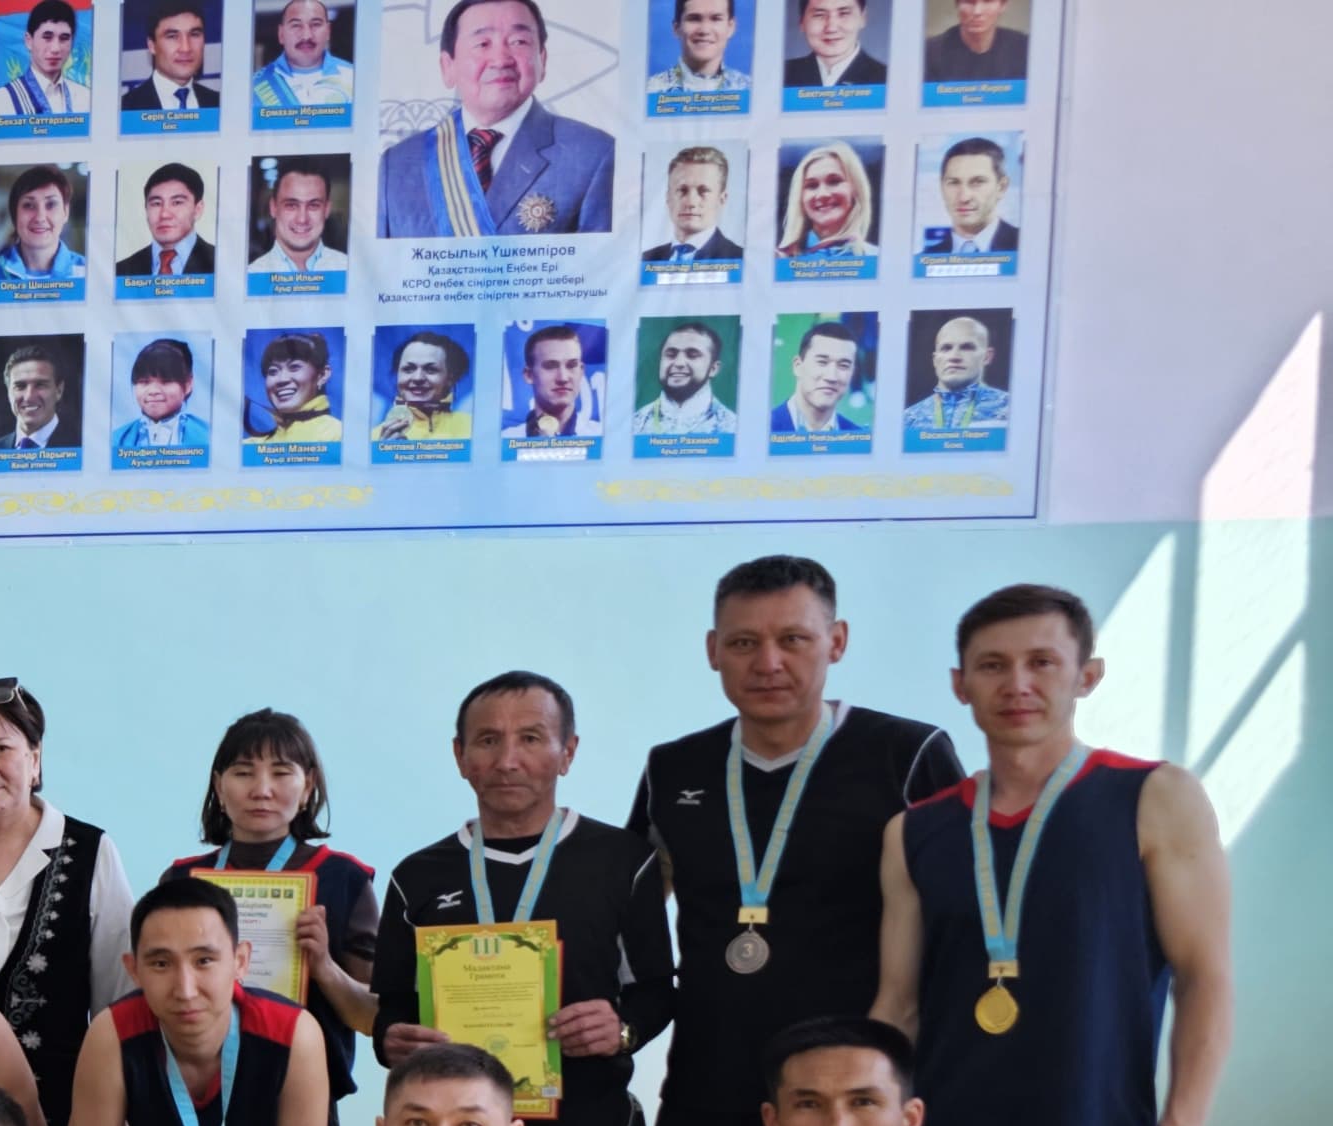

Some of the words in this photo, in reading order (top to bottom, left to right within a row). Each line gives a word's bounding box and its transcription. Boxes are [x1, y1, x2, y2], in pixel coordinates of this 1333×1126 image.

[411, 248, 488, 261] Жақсылық
[492, 245, 576, 259] Үшкемпіров
[506, 263, 538, 274] Еңбек
[541, 262, 558, 273] Ері
[402, 279, 431, 289] КСРО
[513, 277, 543, 287] спорт
[547, 274, 584, 286] шебері
[742, 943, 753, 958] 3
